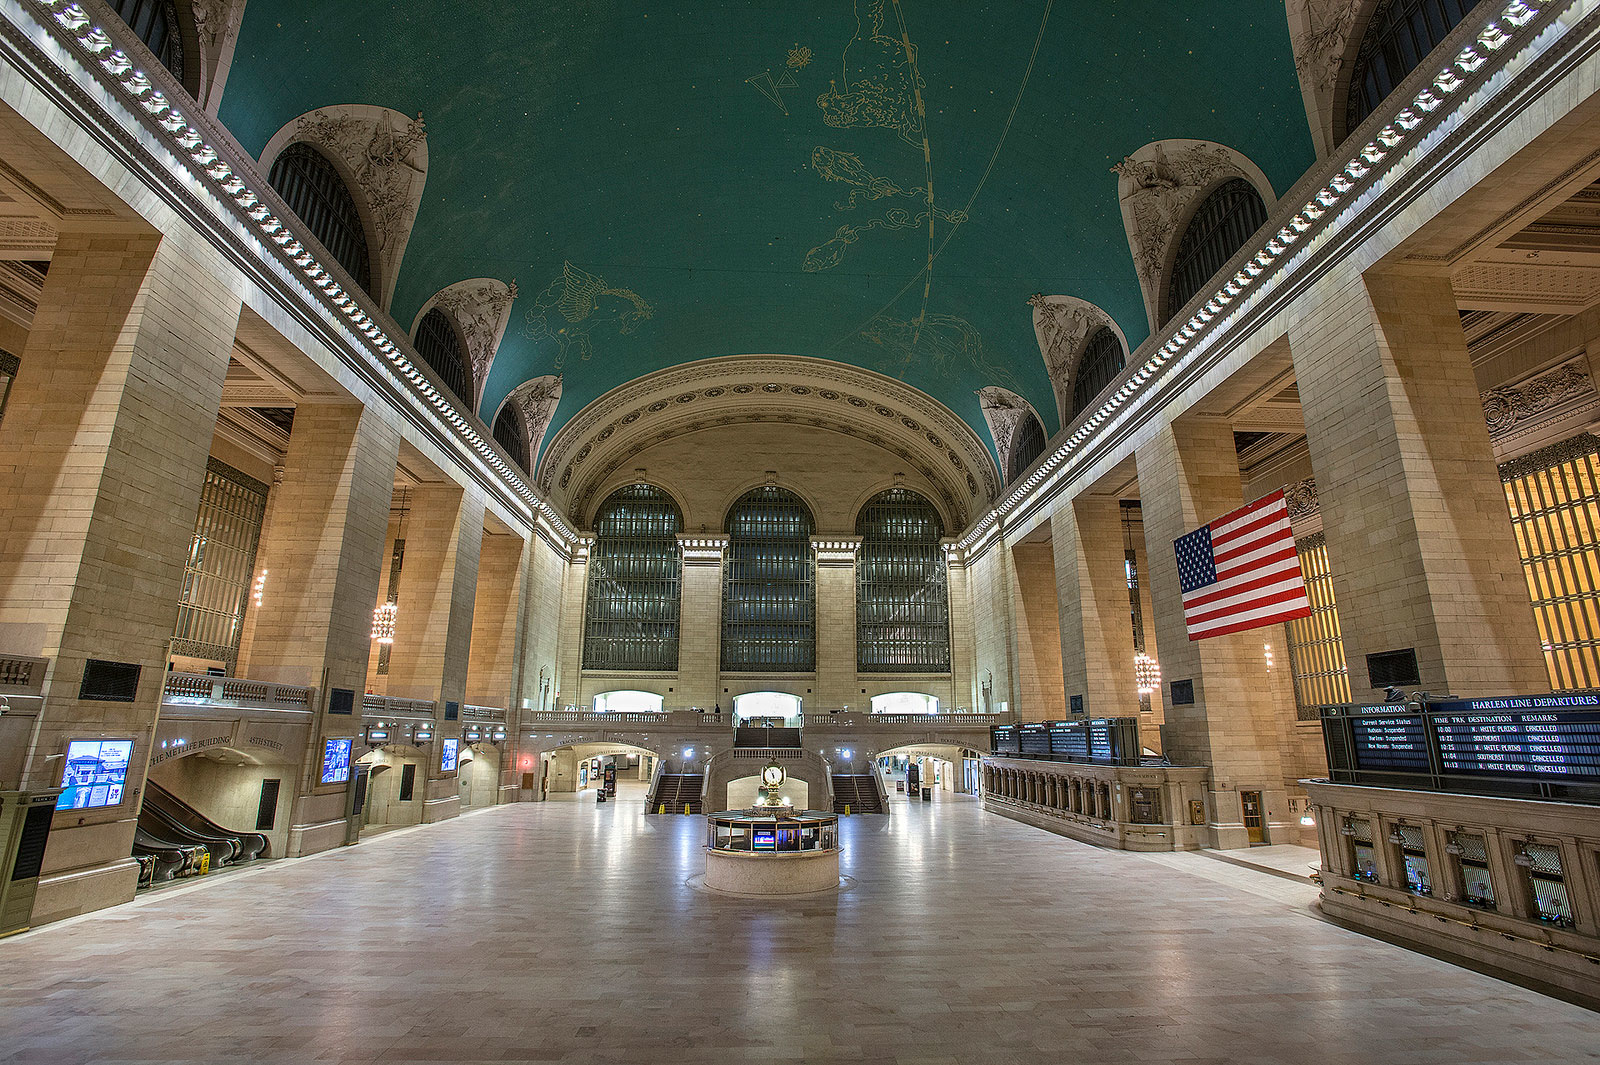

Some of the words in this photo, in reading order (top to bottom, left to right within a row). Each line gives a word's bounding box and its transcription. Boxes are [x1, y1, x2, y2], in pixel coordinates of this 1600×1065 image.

[1472, 700, 1509, 710] HARLEM
[1510, 699, 1532, 708] LINE
[1534, 696, 1598, 706] DEPARTURES
[1361, 705, 1406, 714] INFORMATION
[198, 736, 230, 748] BUILDING
[263, 738, 283, 750] STREET
[1532, 755, 1565, 763] CANCELLED
[1534, 765, 1567, 773] CANCELLED
